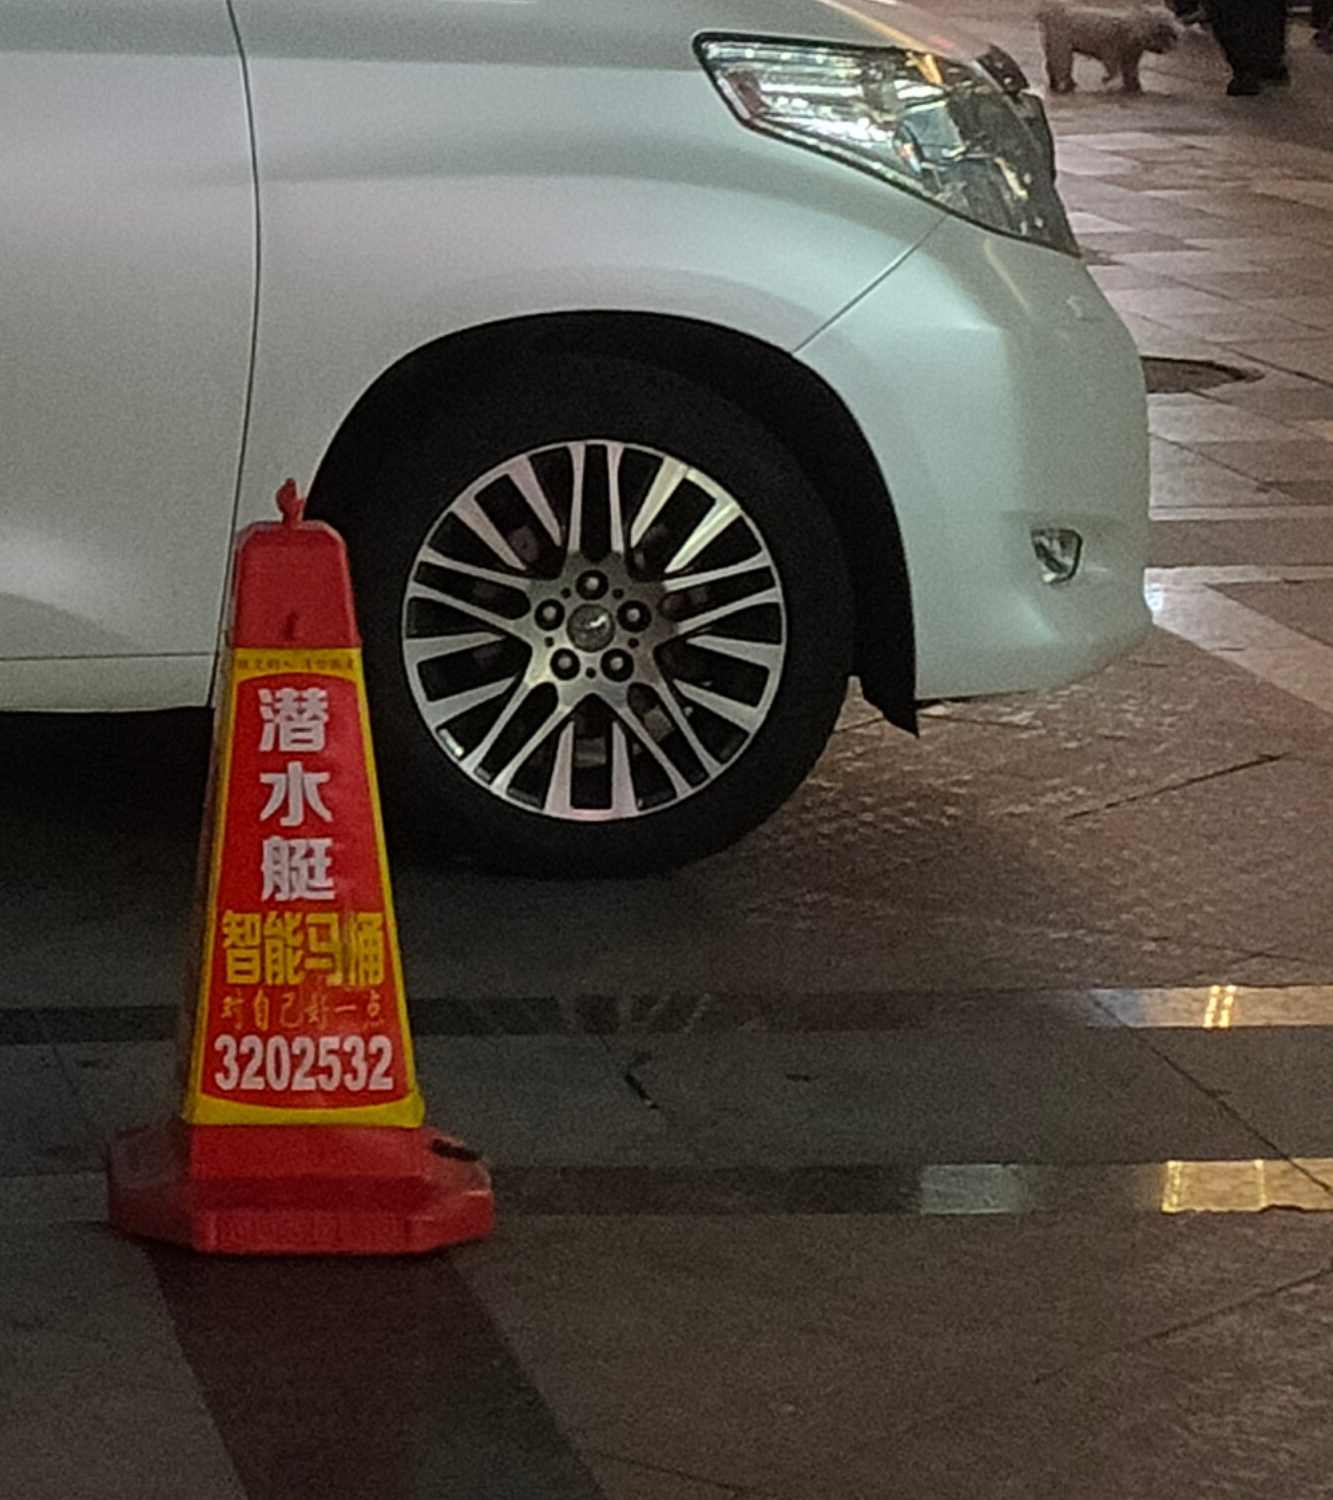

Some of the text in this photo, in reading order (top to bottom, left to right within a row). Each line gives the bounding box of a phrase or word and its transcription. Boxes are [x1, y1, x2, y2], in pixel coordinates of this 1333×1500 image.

[258, 686, 336, 903] 潜水艇
[222, 910, 385, 986] 智能马桶
[220, 987, 385, 1031] 对自己好一点
[214, 1034, 394, 1091] 3202532
